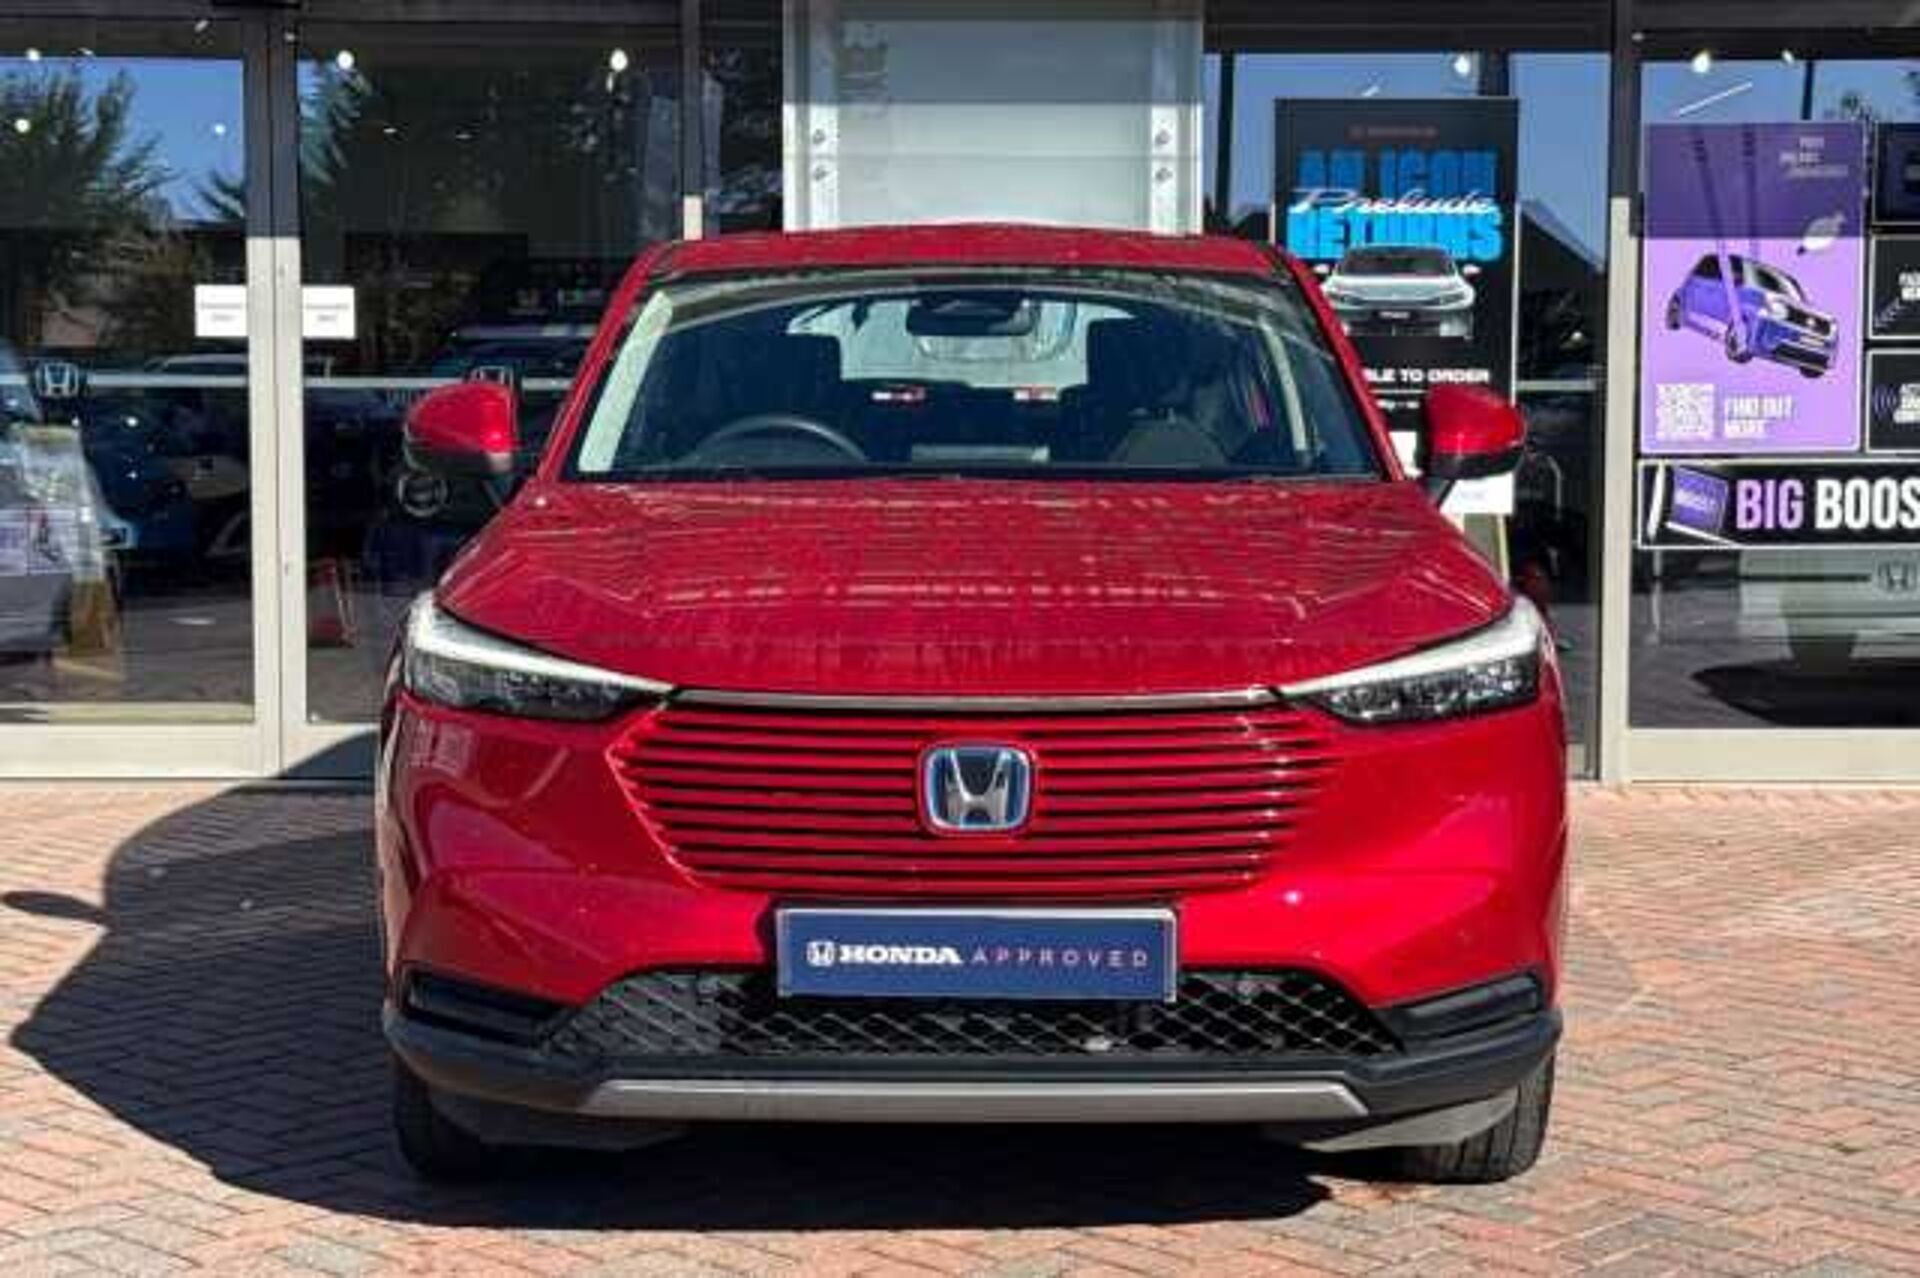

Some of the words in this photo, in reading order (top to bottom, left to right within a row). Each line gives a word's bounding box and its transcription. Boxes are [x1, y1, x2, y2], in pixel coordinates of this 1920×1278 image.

[1400, 368, 1424, 382] TO
[1427, 368, 1490, 384] ORDER
[1735, 479, 1804, 530] BIG
[839, 942, 962, 965] HONDA
[971, 946, 1148, 968] APPROVED
